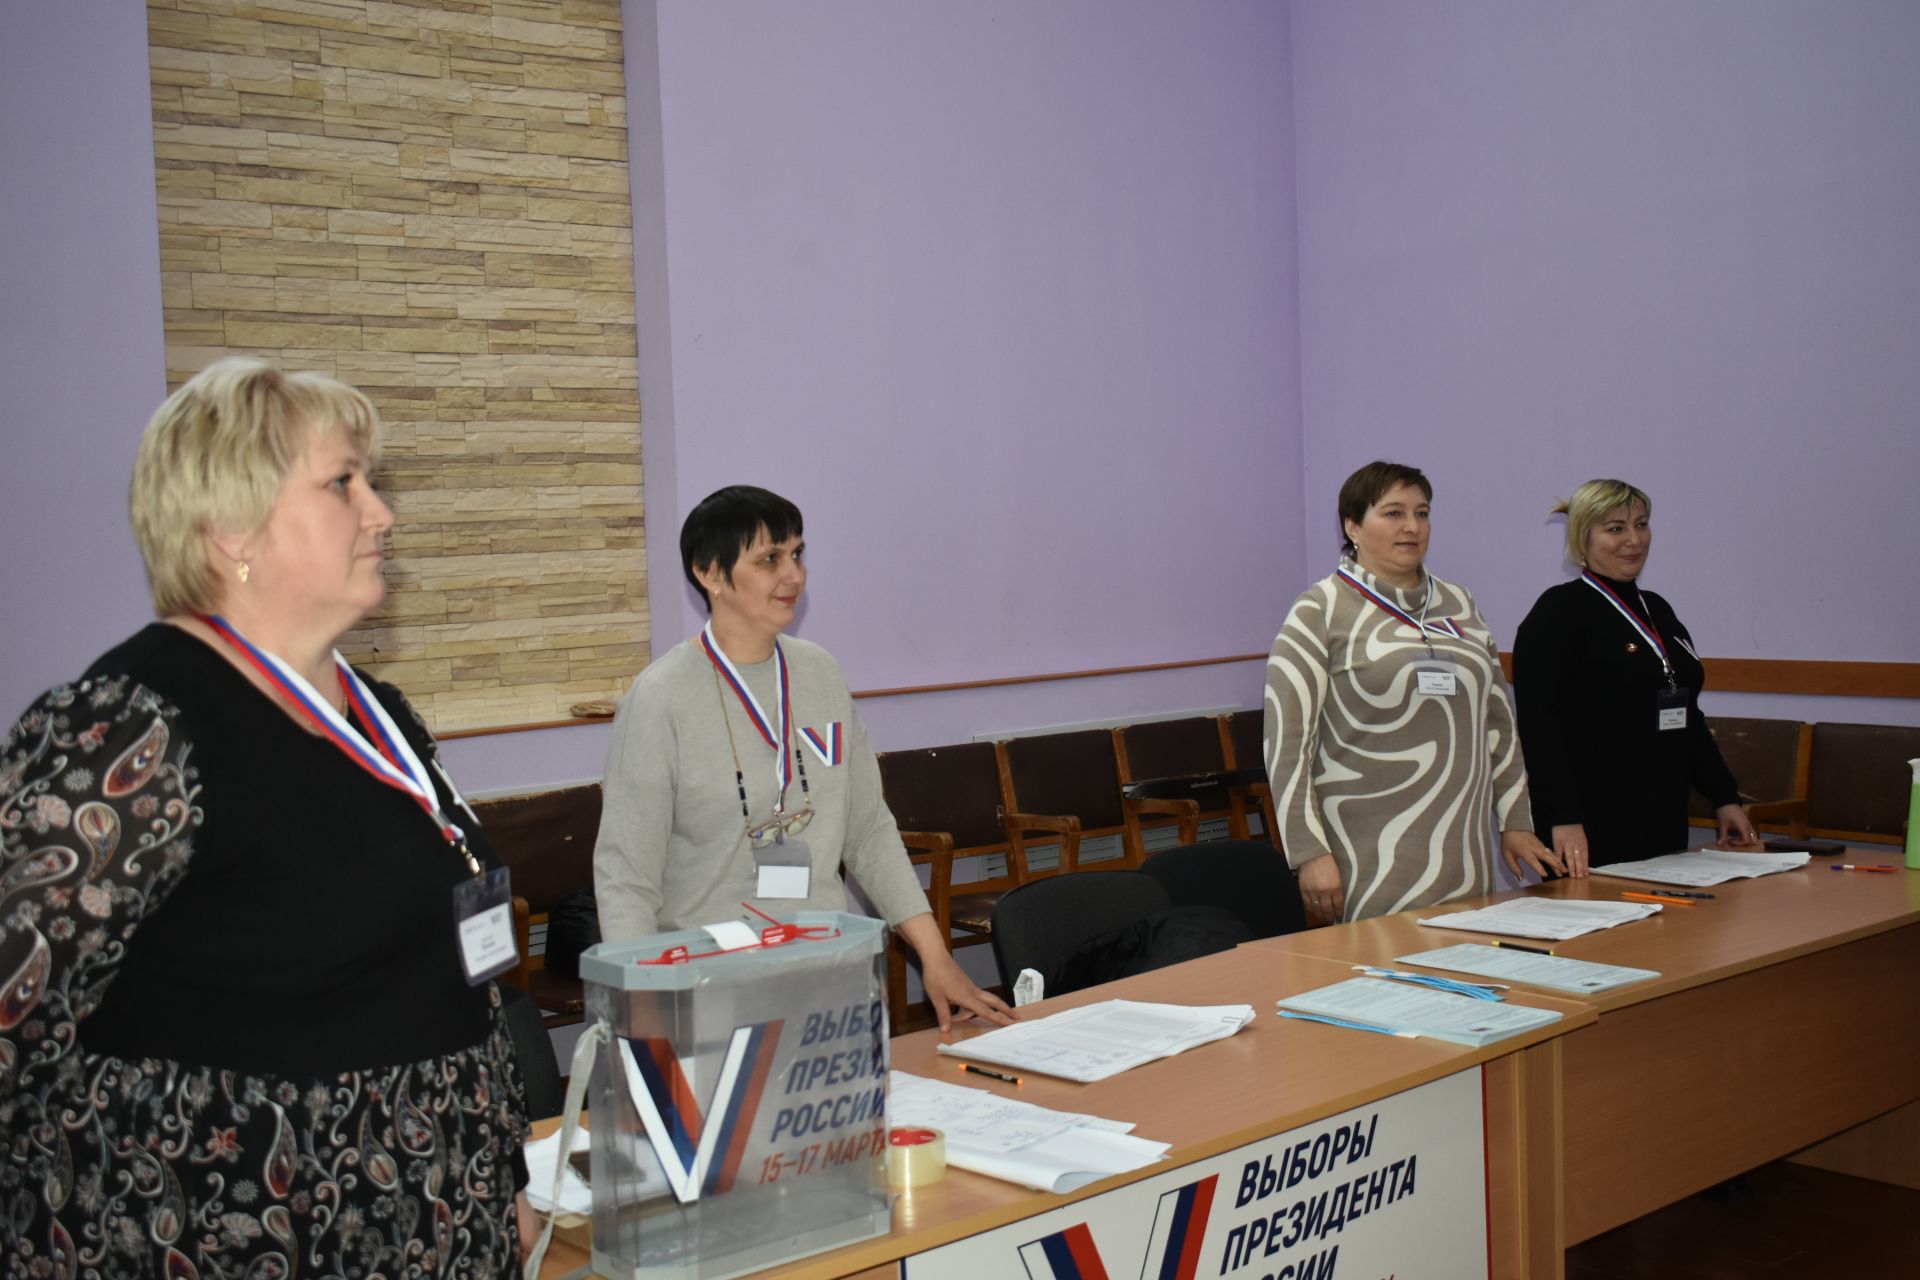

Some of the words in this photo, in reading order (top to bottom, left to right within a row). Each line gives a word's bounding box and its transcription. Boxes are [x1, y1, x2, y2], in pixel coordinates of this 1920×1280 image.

[770, 1087, 885, 1143] РОССИИ
[1235, 1113, 1379, 1209] ВЫБОРЫ
[1219, 1154, 1417, 1276] ПРЕЗИДЕНТА
